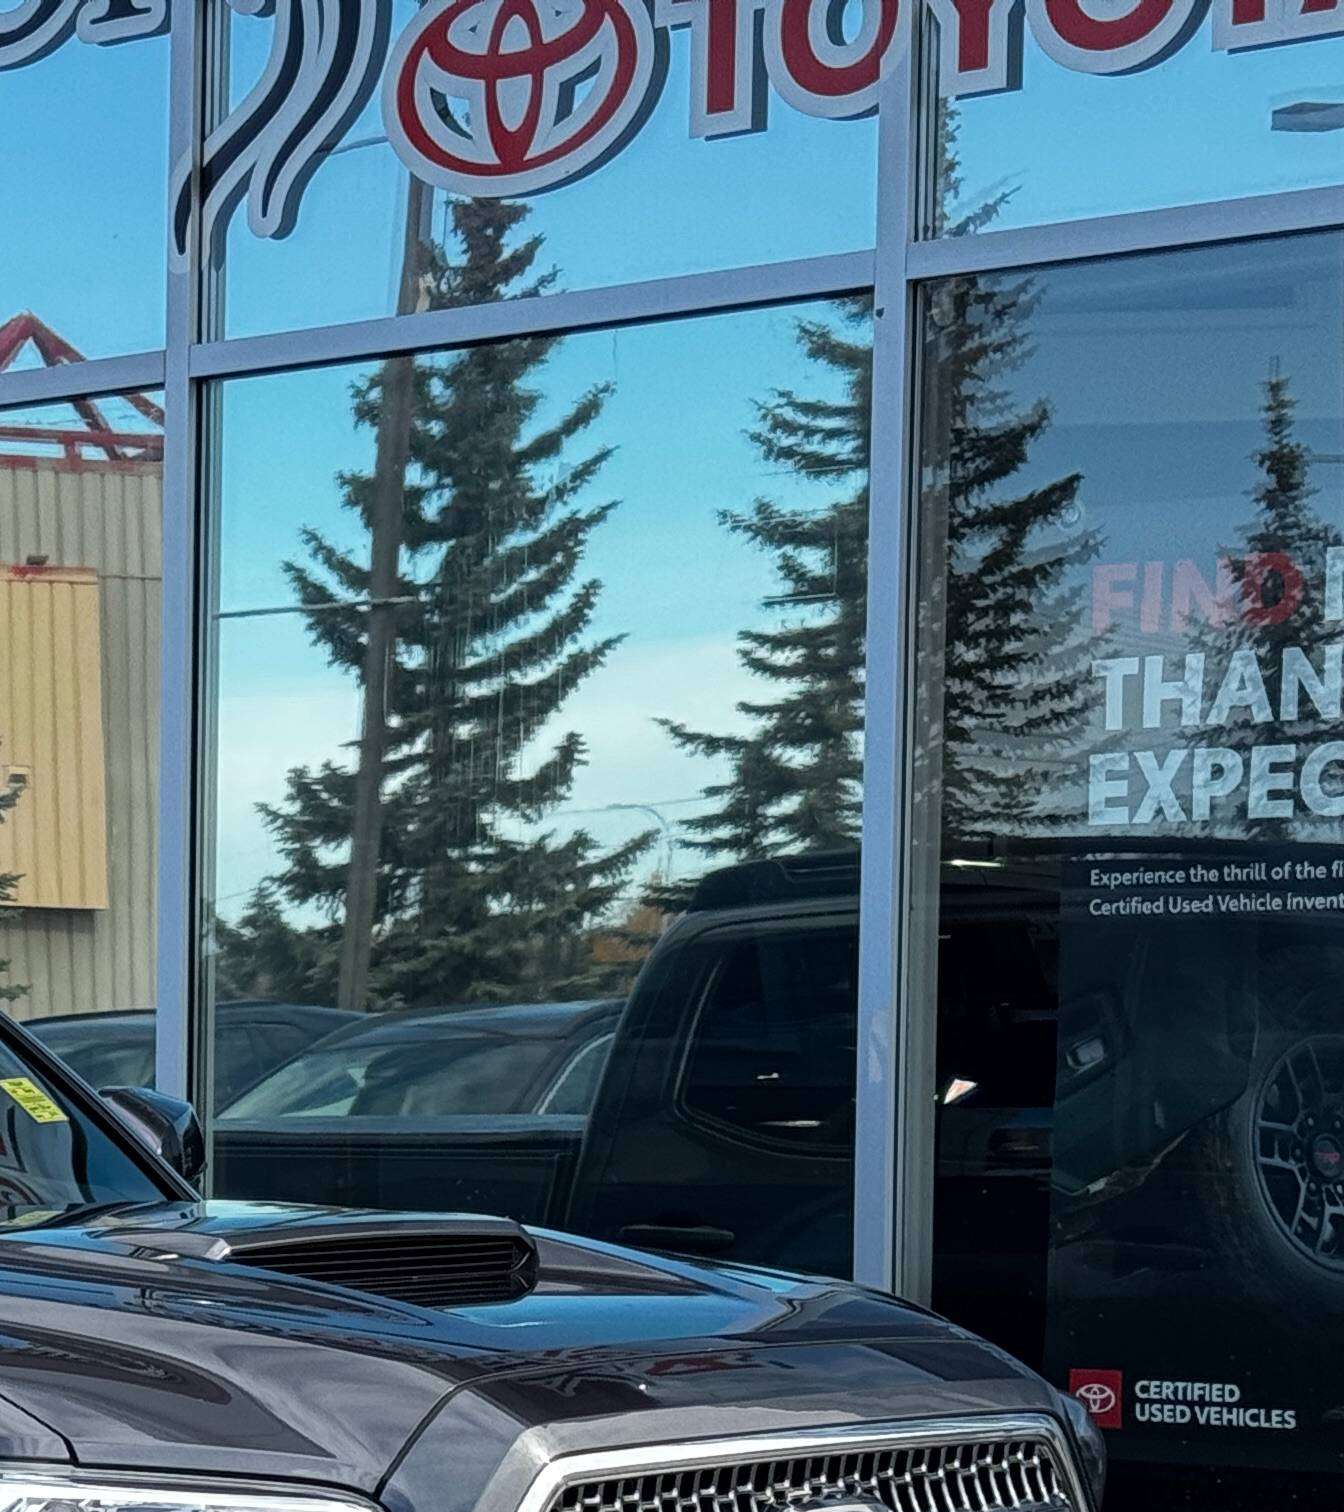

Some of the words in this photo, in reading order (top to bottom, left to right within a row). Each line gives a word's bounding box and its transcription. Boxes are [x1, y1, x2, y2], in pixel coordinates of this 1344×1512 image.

[1091, 551, 1303, 637] FIND
[1091, 644, 1344, 731] THAN
[1090, 867, 1186, 890] Experience
[1188, 864, 1219, 883] the
[1223, 862, 1267, 882] thrill
[1271, 861, 1292, 880] of
[1294, 861, 1327, 880] the
[1089, 896, 1164, 916] Certified
[1168, 894, 1213, 914] Used
[1217, 893, 1283, 912] Vehicle
[1134, 1380, 1241, 1403] CERTIFIED
[1135, 1403, 1192, 1424] USED
[1194, 1405, 1297, 1429] VEHICLES
